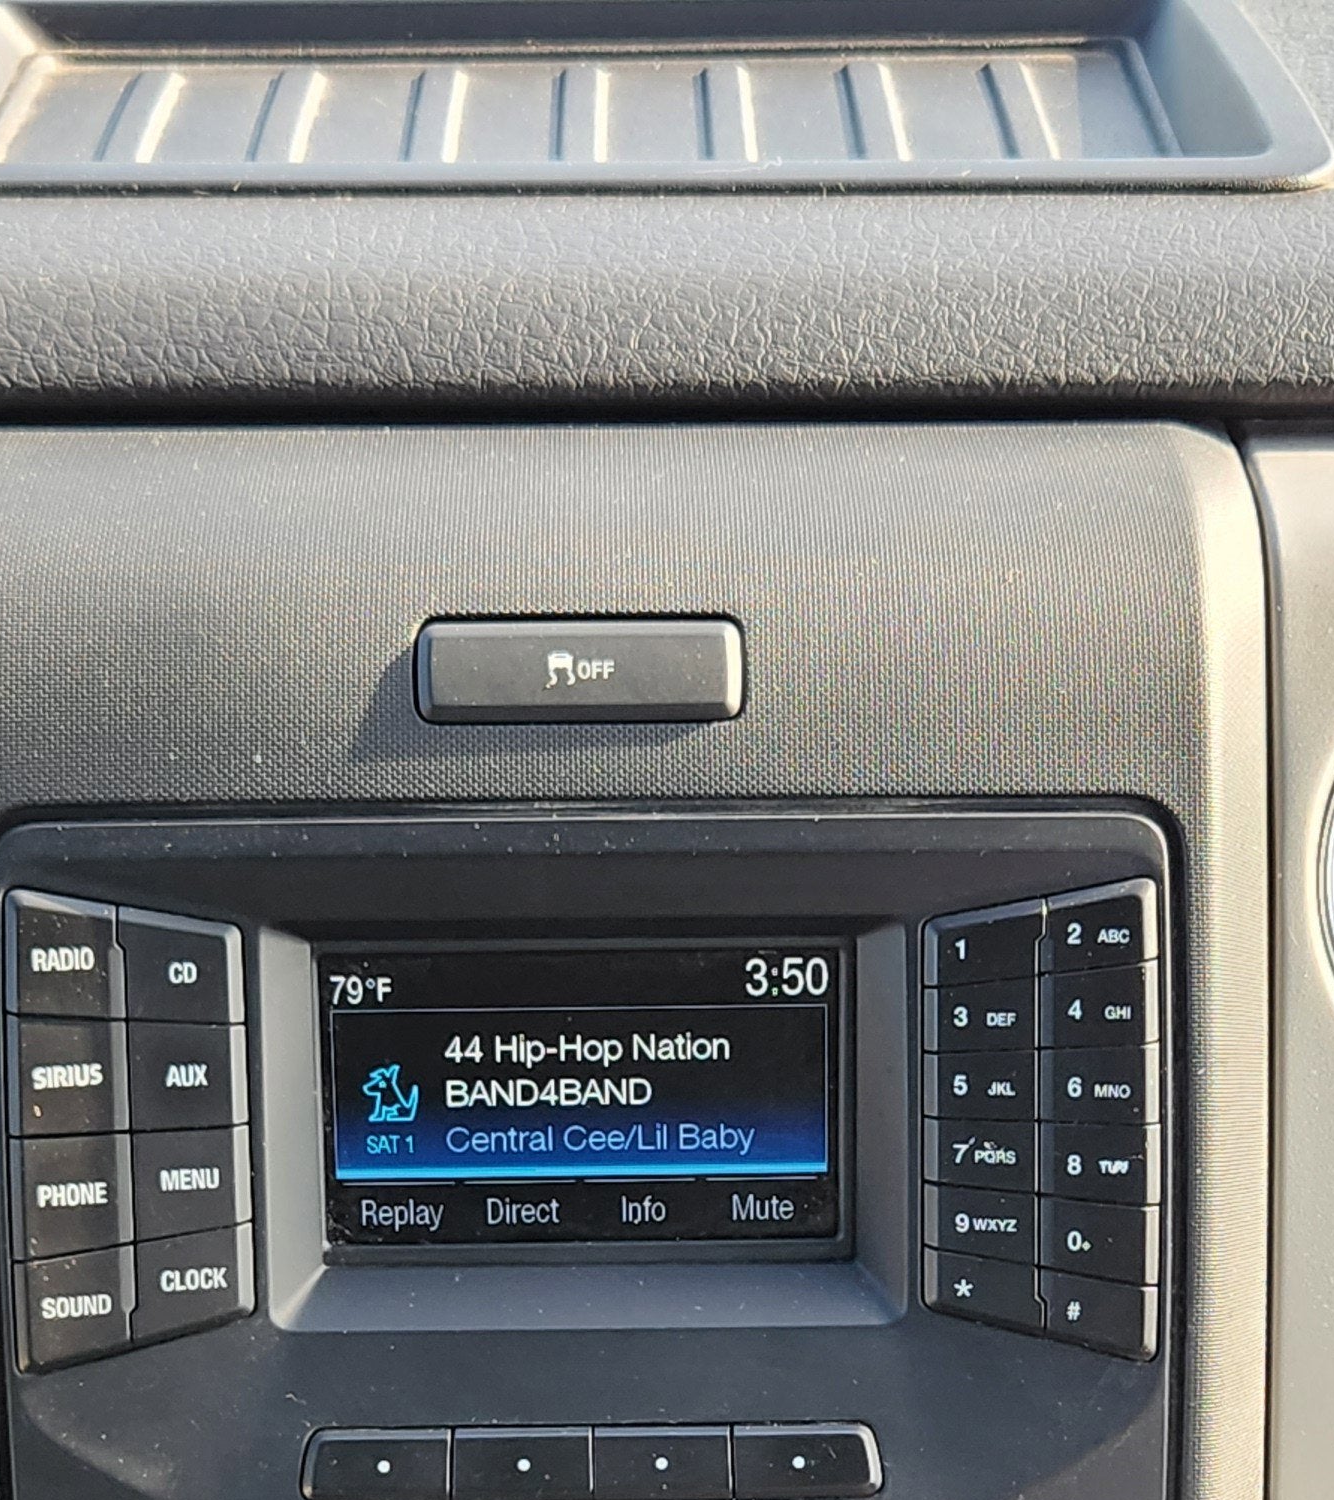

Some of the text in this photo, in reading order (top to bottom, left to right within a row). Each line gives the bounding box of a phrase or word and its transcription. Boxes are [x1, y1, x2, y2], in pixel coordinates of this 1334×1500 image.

[577, 659, 615, 680] OFF
[1067, 924, 1130, 945] 2 ABC
[31, 947, 95, 972] RADIO
[955, 939, 967, 960] 1
[169, 962, 197, 984] CD
[745, 957, 829, 997] 3:50
[953, 1007, 1016, 1027] 3 DEF
[1067, 1000, 1131, 1021] 4 GHI
[444, 1034, 730, 1068] 44 Hip-Hop Nation
[32, 1063, 103, 1090] SIRIUS
[166, 1065, 208, 1087] AUX
[953, 1075, 1016, 1096] 5 JKL
[446, 1078, 652, 1109] BAND4BAND
[1067, 1077, 1131, 1099] 6 MNO
[367, 1135, 415, 1155] SAT 1
[446, 1124, 755, 1156] Central Cee/Lil Baby
[953, 1143, 969, 1164] 7
[1067, 1154, 1082, 1175] 8
[161, 1168, 220, 1191] MENU
[37, 1182, 108, 1208] PHONE
[362, 1199, 444, 1232] Replay
[487, 1197, 560, 1225] Direct
[621, 1195, 666, 1224] Info
[731, 1194, 795, 1221] Mute
[955, 1213, 1017, 1233] 9 WXYZ
[161, 1267, 227, 1292] CLOCK
[42, 1294, 112, 1319] SOUND
